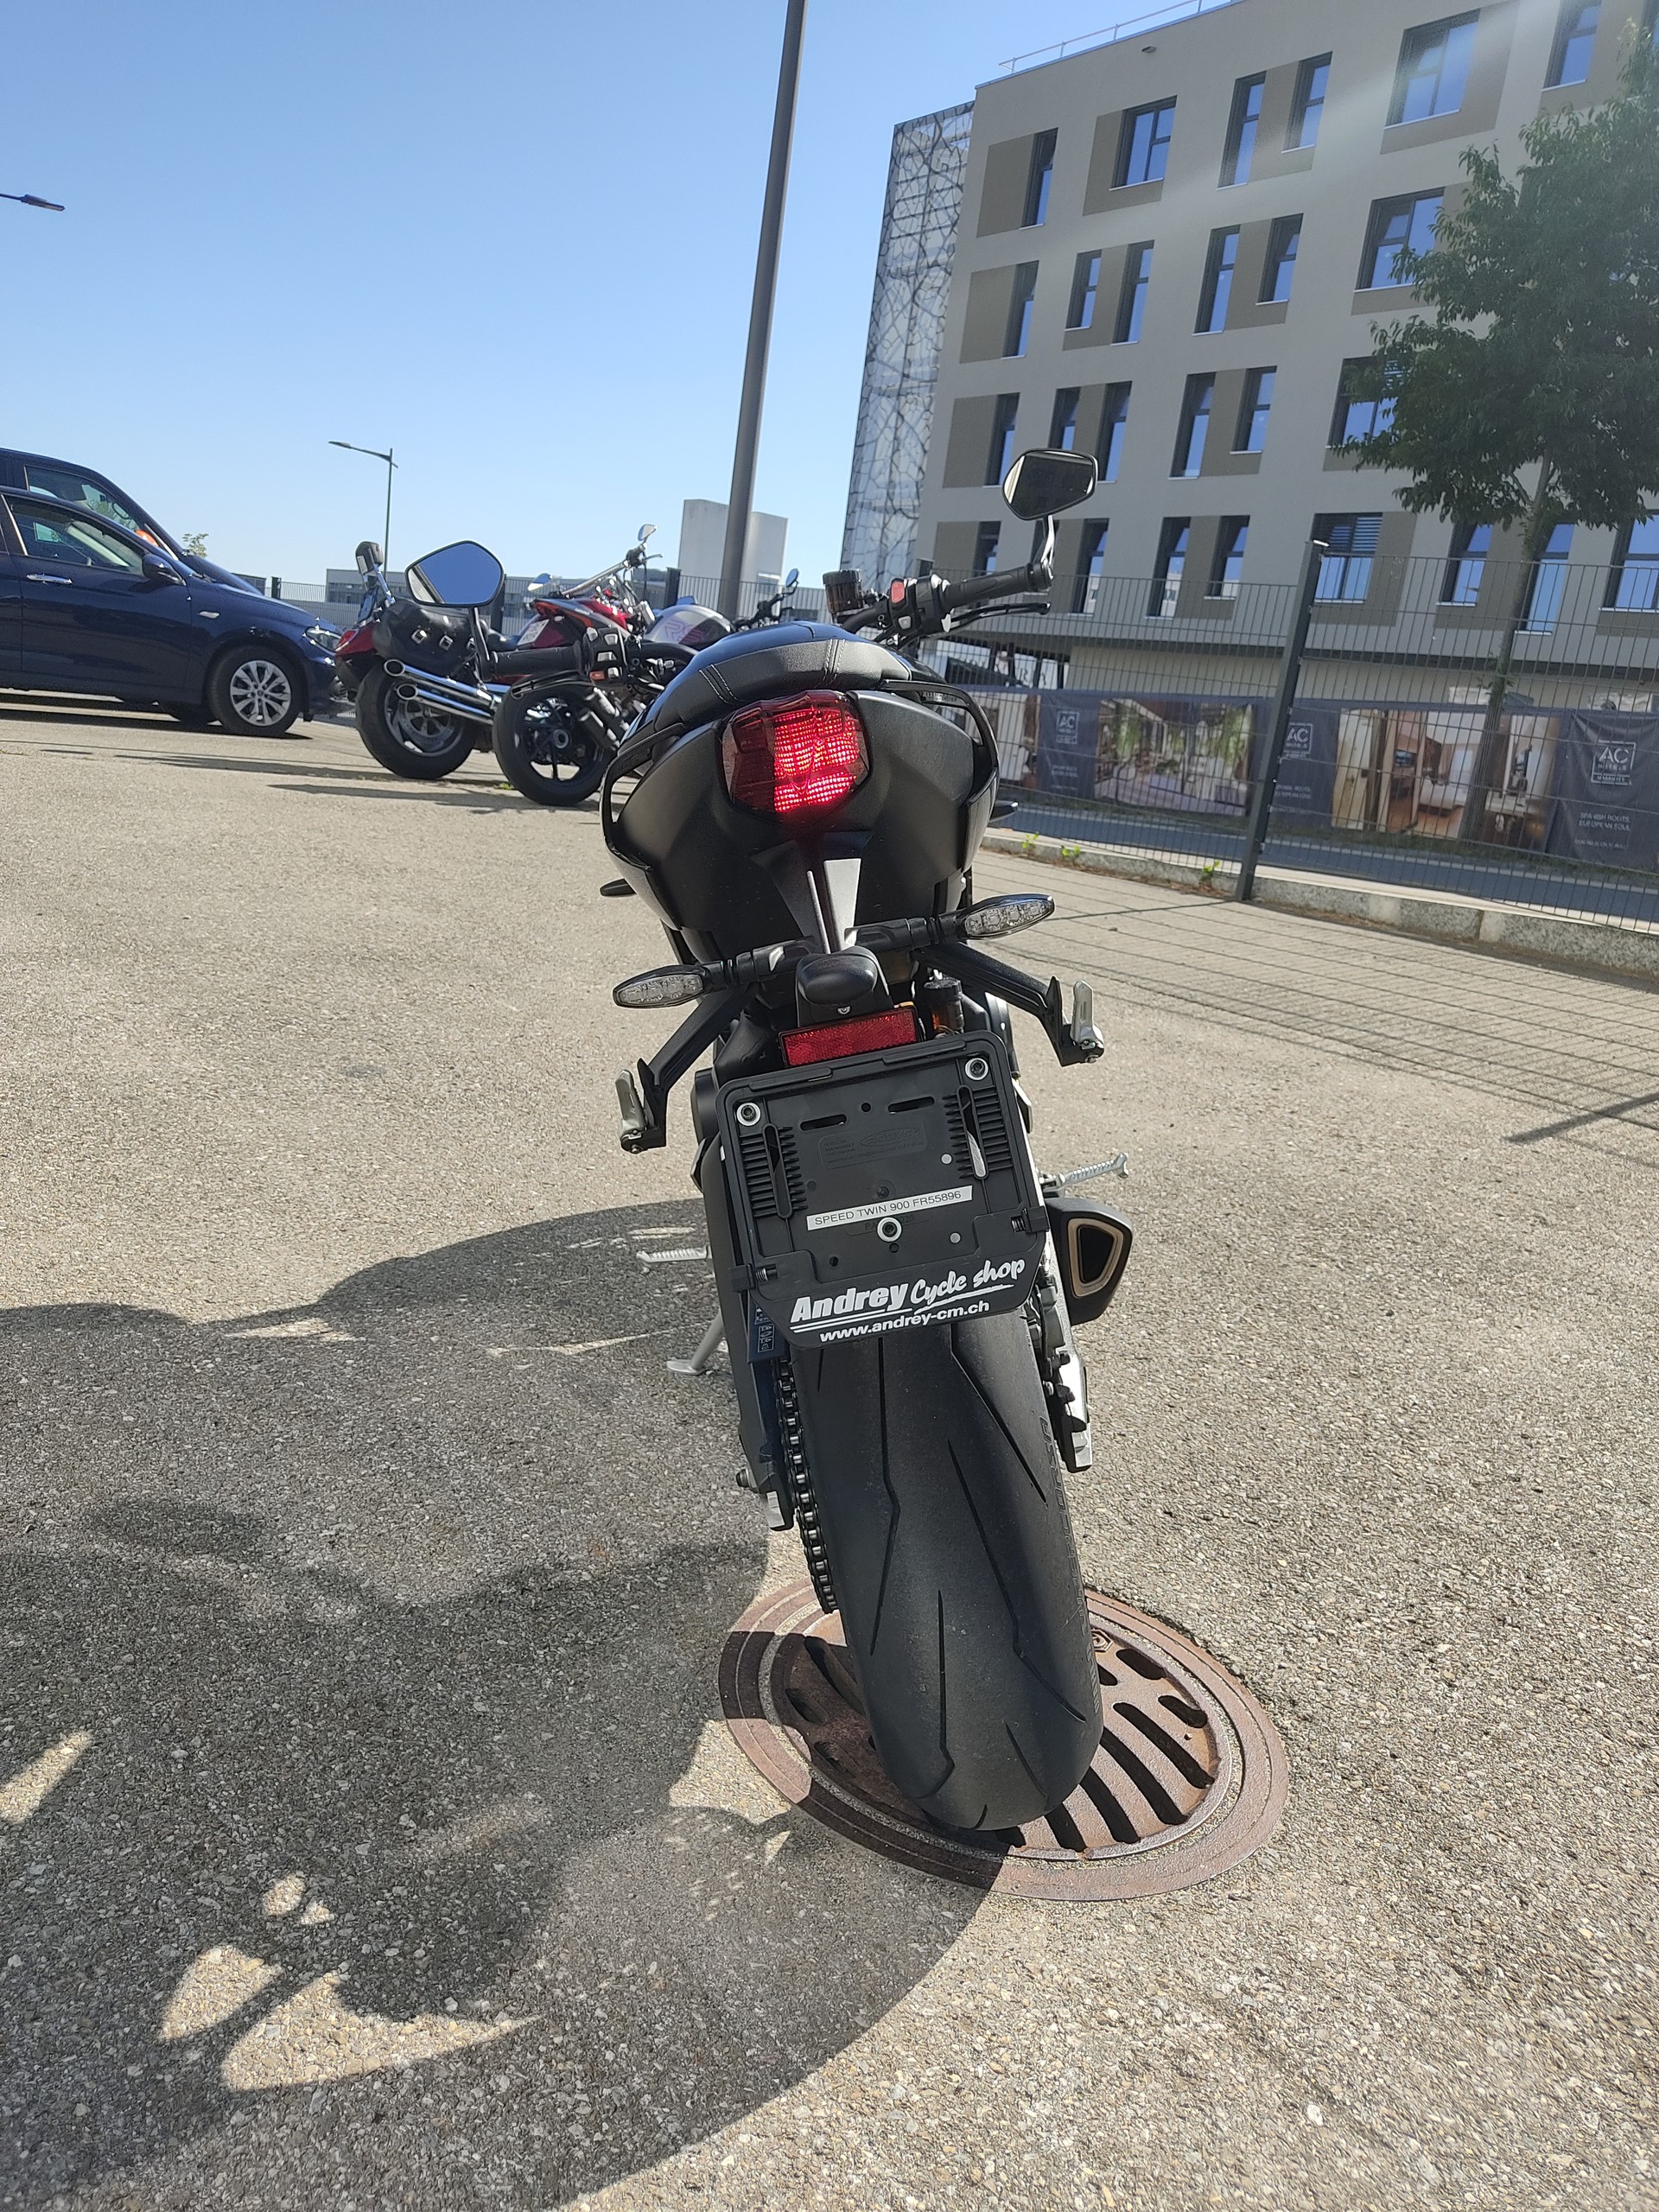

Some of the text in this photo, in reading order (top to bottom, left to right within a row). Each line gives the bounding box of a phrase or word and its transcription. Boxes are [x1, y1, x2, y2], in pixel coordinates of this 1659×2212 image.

[1059, 715, 1075, 728] AC
[1287, 728, 1308, 742] AC
[1599, 747, 1629, 764] AC
[815, 1211, 855, 1225] SPEED
[856, 1205, 887, 1217] TWIN
[889, 1201, 910, 1211] 900
[912, 1190, 962, 1207] FR55896
[790, 1259, 1026, 1323] Andrey Cycle shop
[819, 1300, 990, 1342] www.andrey-cm.ch
